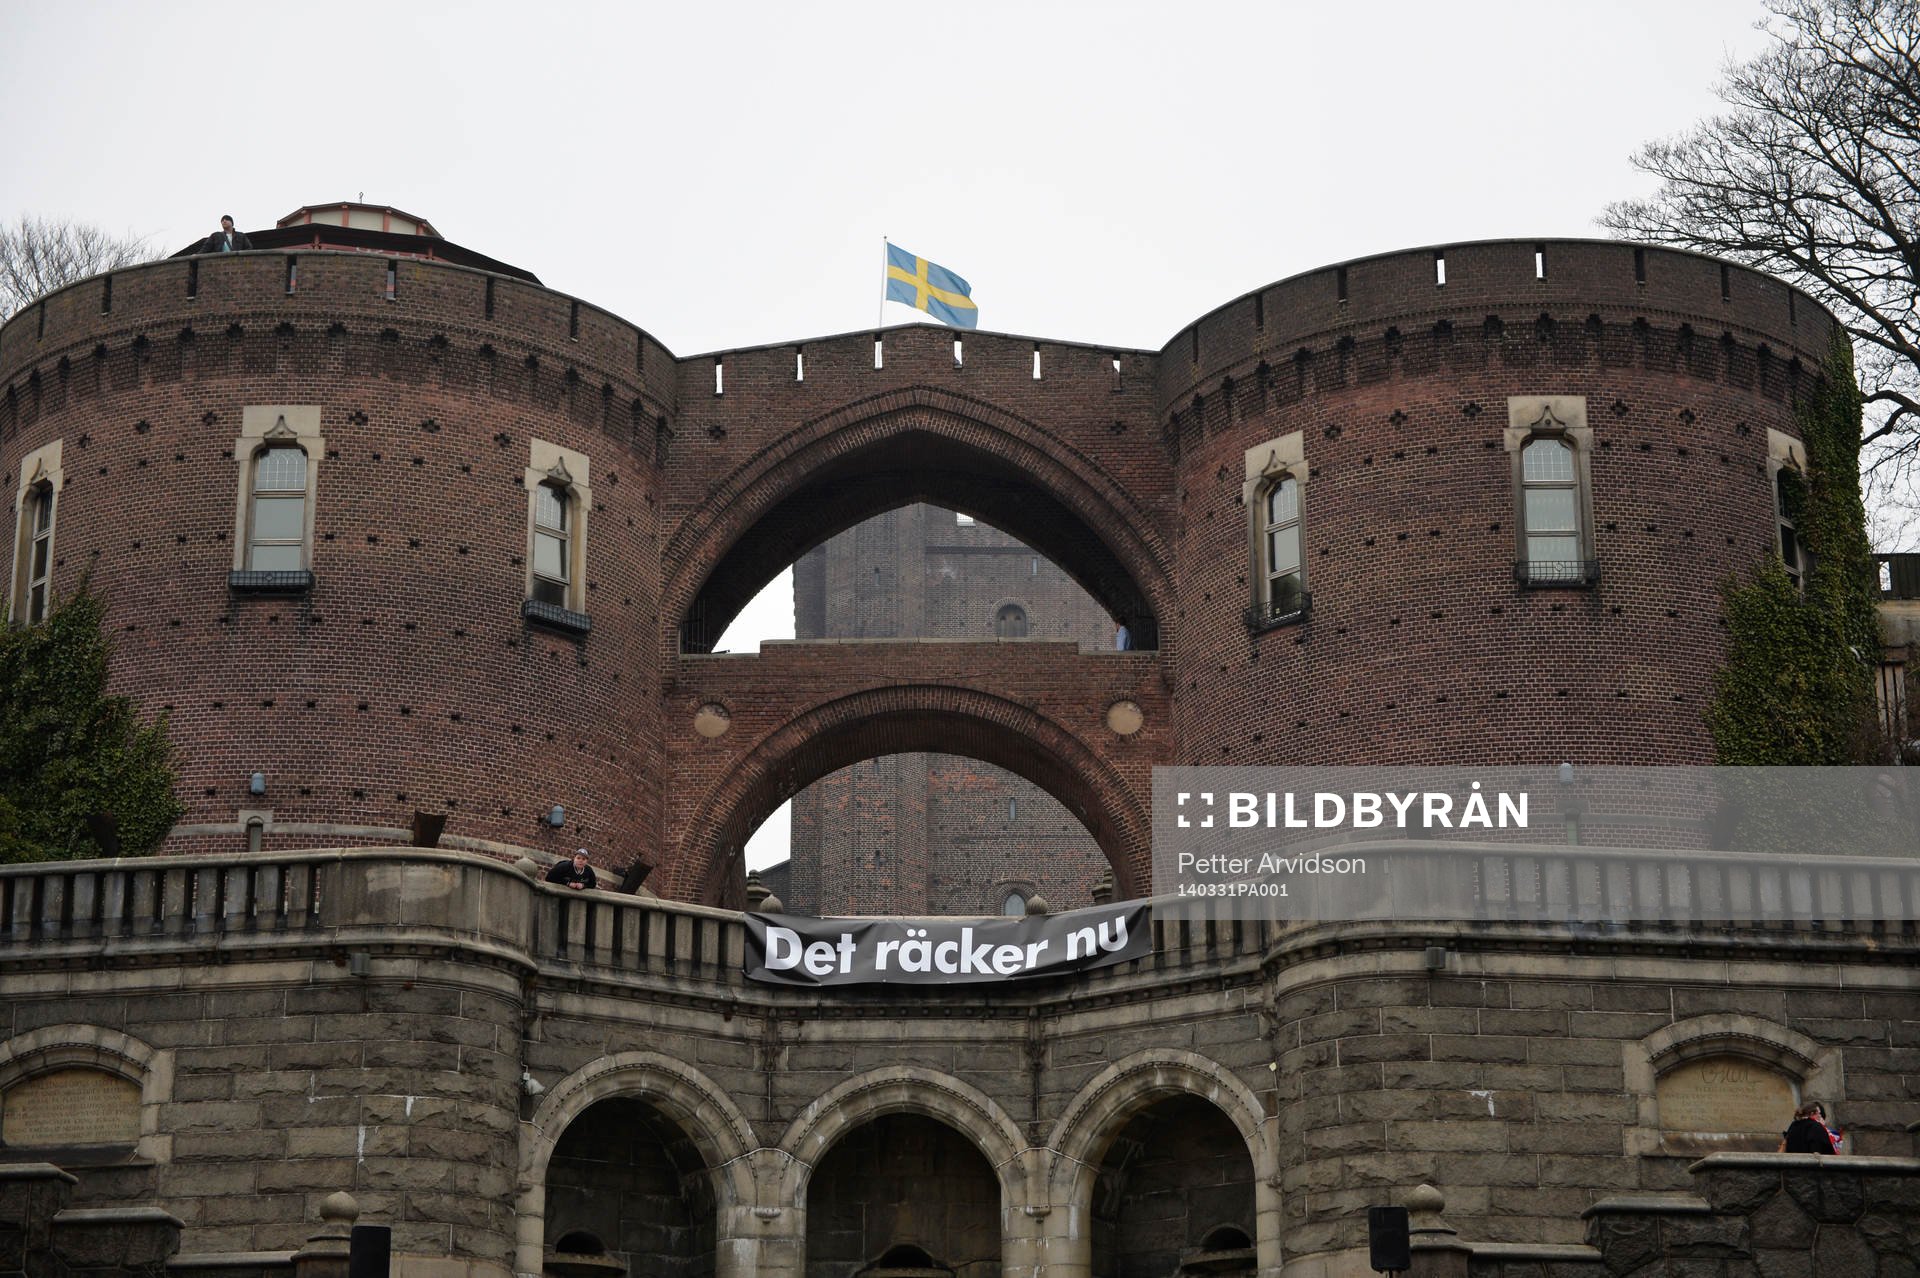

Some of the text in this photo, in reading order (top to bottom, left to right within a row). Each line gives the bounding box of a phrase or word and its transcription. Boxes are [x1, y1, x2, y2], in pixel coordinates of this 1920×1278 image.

[764, 915, 1130, 976] Det räcker nu
